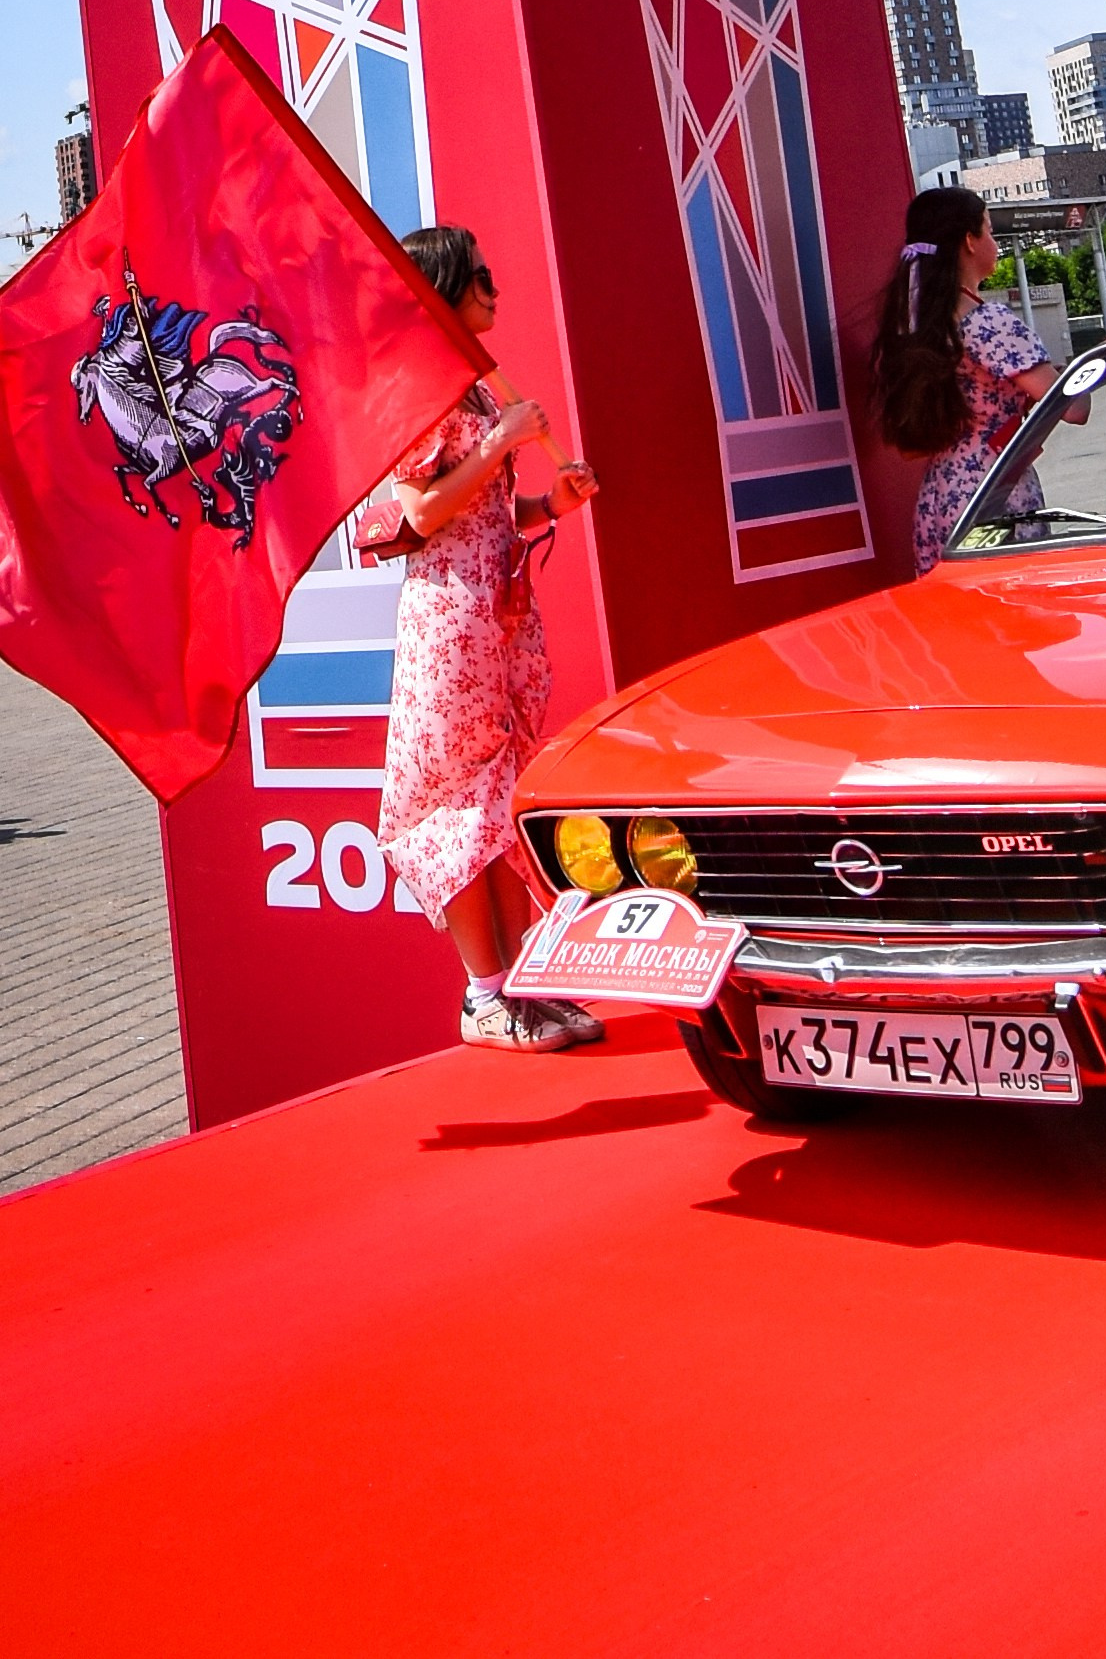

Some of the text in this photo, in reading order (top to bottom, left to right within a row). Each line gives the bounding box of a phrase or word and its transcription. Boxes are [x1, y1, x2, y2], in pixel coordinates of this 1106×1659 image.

[1073, 367, 1097, 385] 57
[981, 834, 1053, 852] OPEL
[616, 903, 660, 934] 57
[553, 940, 721, 973] КУБОК МОСКВЫ
[547, 965, 710, 981] ПО ИСТОРИЧЕСКОМУ РАЛЛИ
[772, 1017, 1055, 1086] К374ЕХ 799
[1000, 1071, 1040, 1091] RUS
